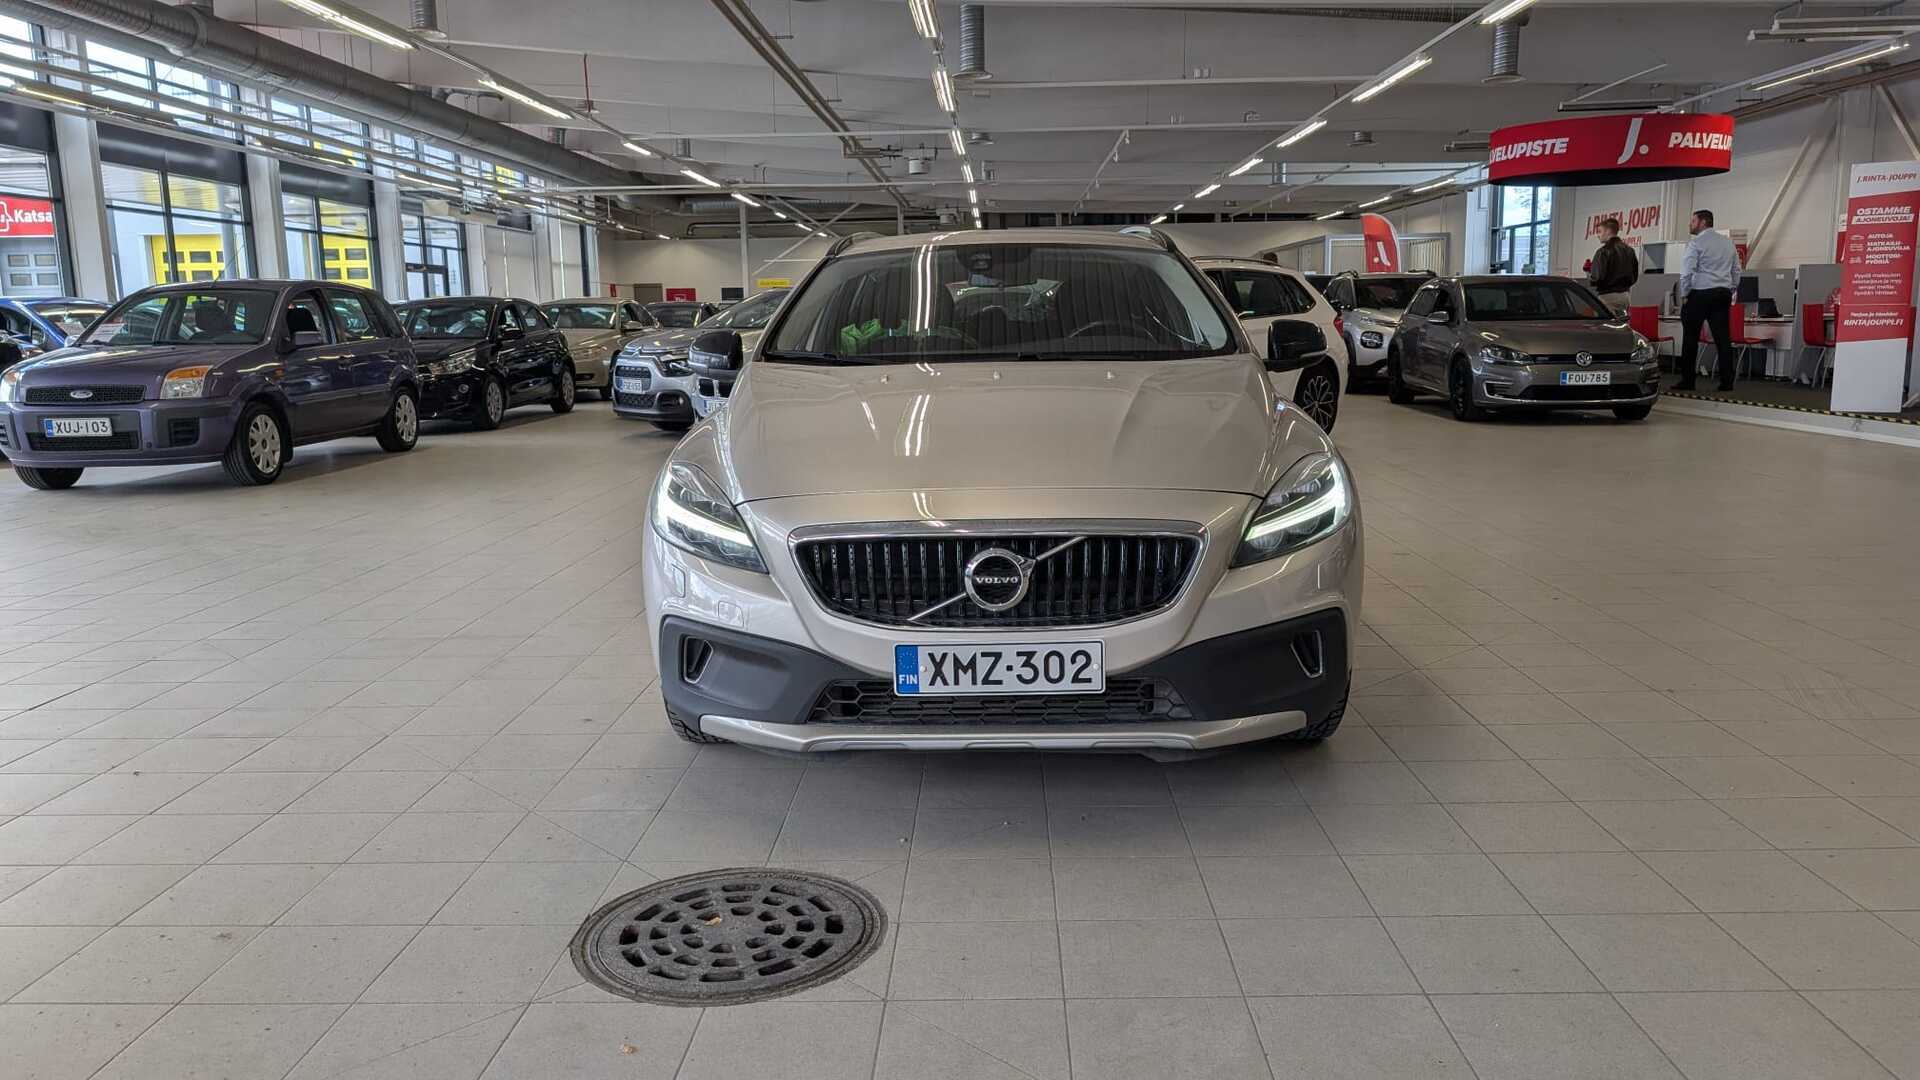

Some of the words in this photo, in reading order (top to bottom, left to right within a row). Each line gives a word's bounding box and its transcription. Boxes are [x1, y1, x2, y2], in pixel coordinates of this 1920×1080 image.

[1857, 206, 1911, 215] OSTAMME
[55, 420, 109, 434] XUJ-103
[975, 576, 1019, 584] VOLVO
[899, 674, 918, 685] FIN
[927, 650, 1093, 687] XMZ-302
